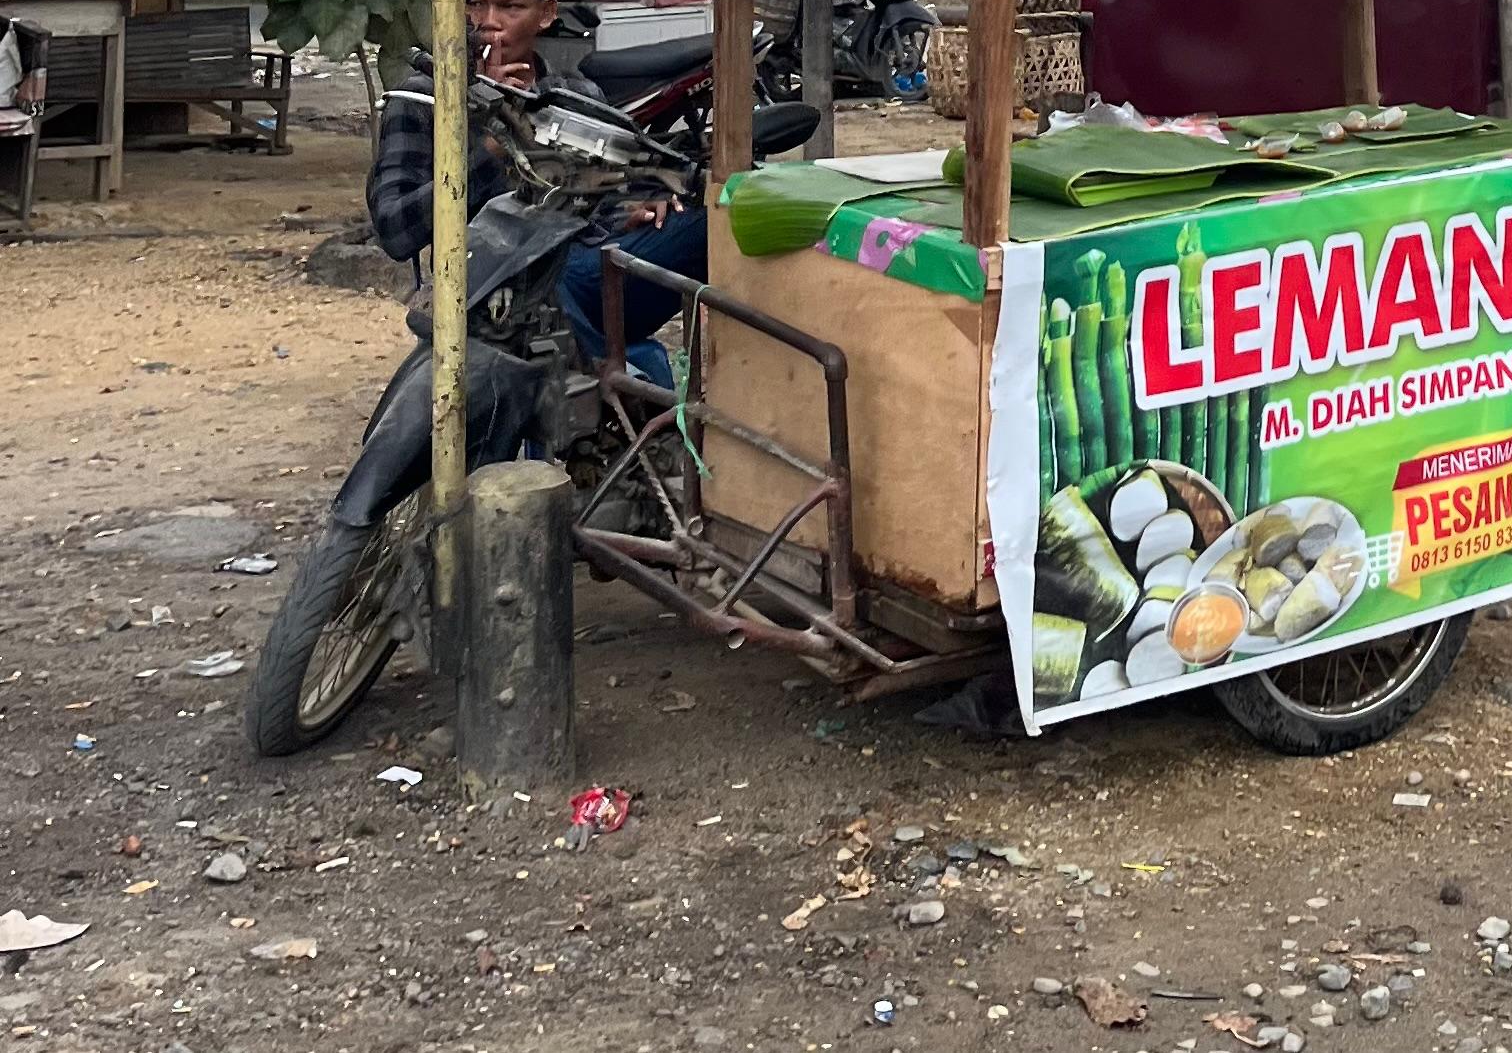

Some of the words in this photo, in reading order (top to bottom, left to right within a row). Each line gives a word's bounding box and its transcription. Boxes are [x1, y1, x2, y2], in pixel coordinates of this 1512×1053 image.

[1263, 404, 1300, 444] M.
[1310, 382, 1391, 432] DIAH
[1411, 544, 1450, 573] 0813
[1453, 532, 1492, 560] 6150
